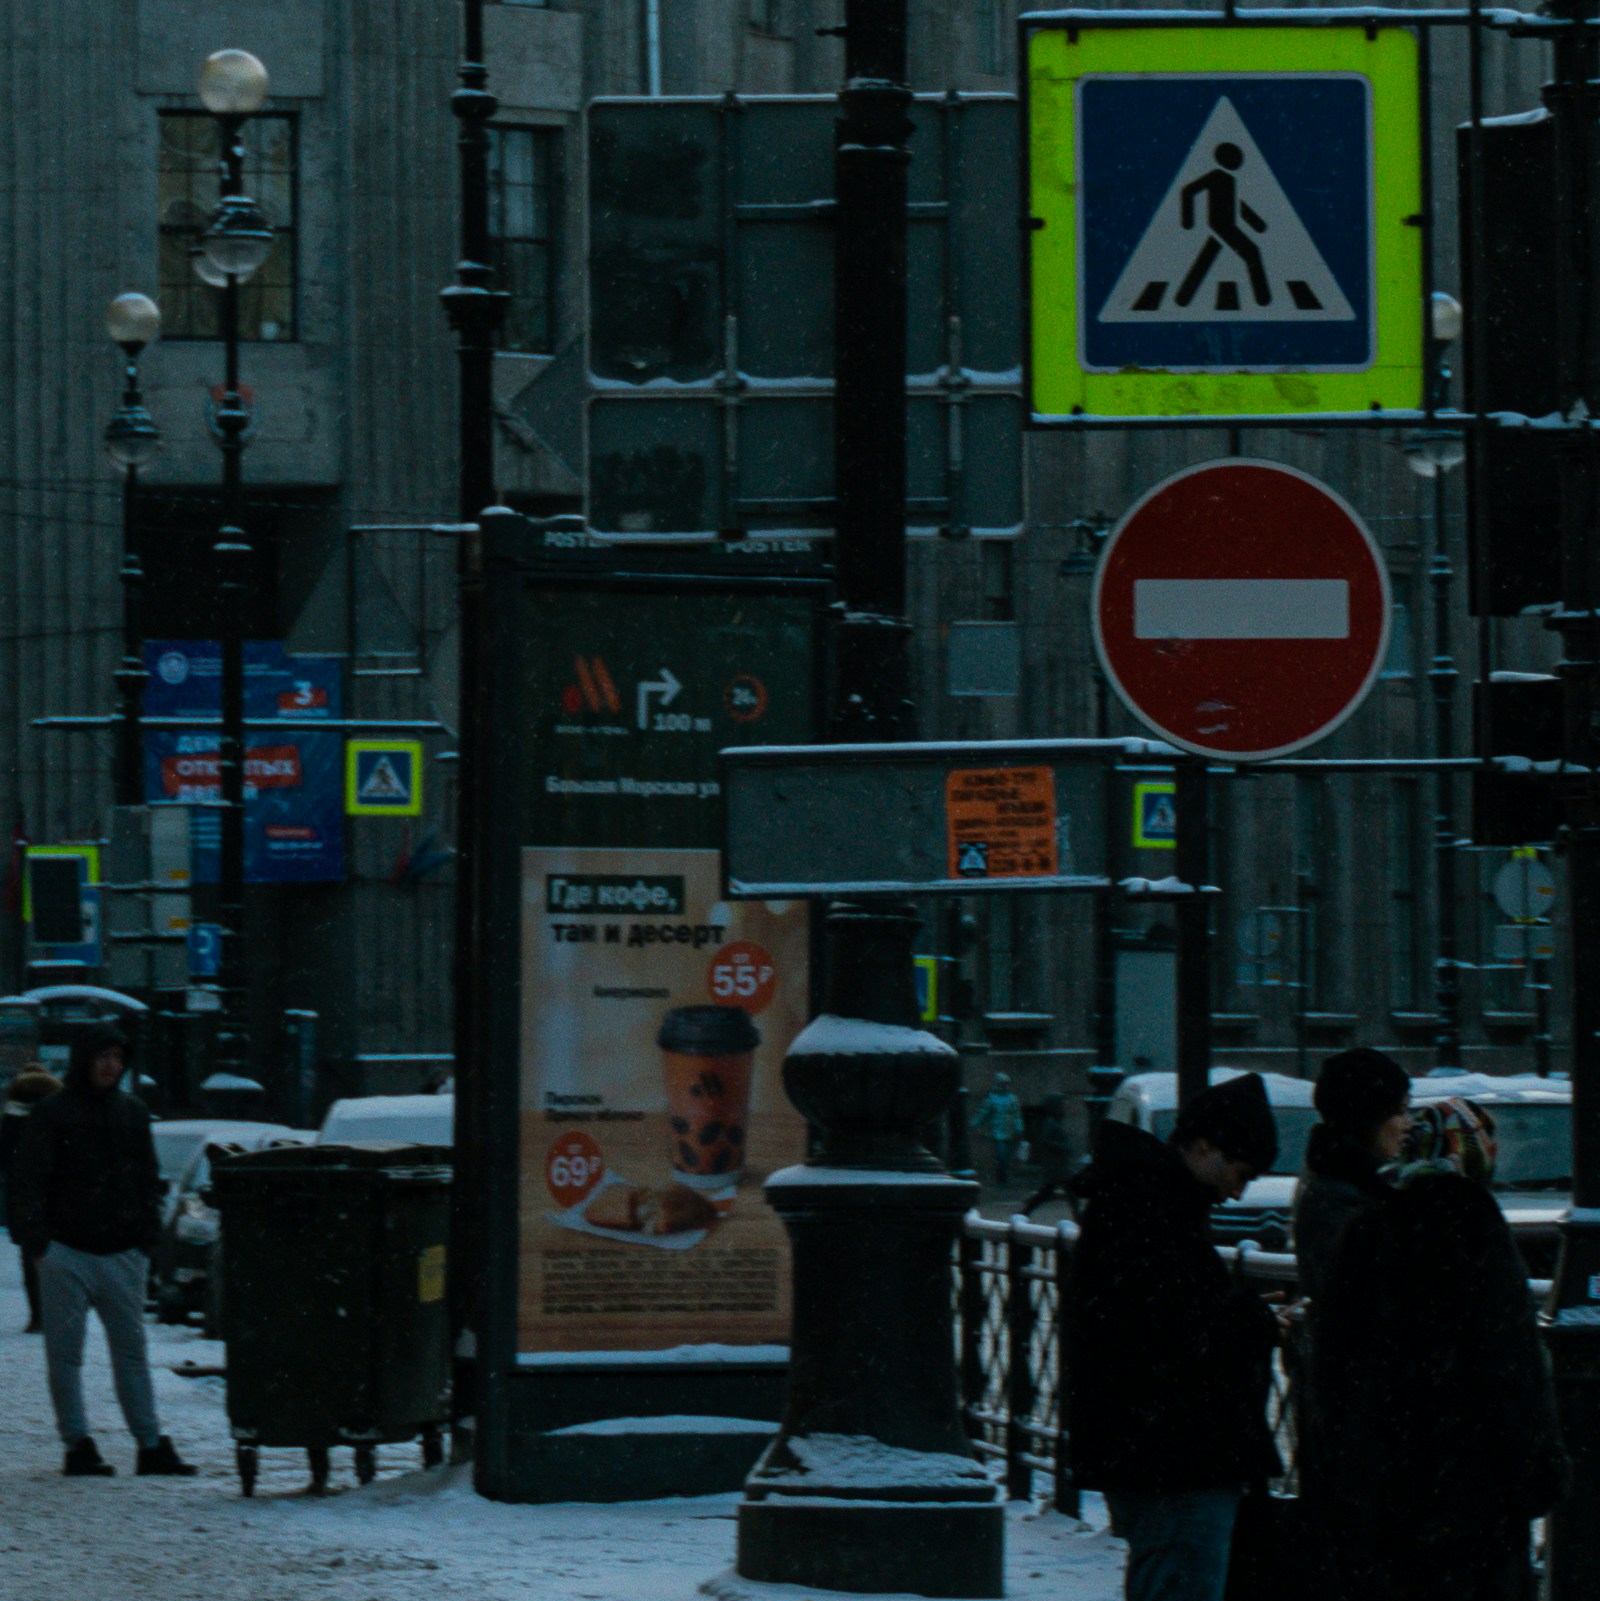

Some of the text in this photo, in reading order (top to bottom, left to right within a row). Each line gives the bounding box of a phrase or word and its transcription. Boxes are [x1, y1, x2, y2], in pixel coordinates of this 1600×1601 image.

[551, 879, 678, 911] Где кофе,
[552, 924, 725, 948] так и десерт
